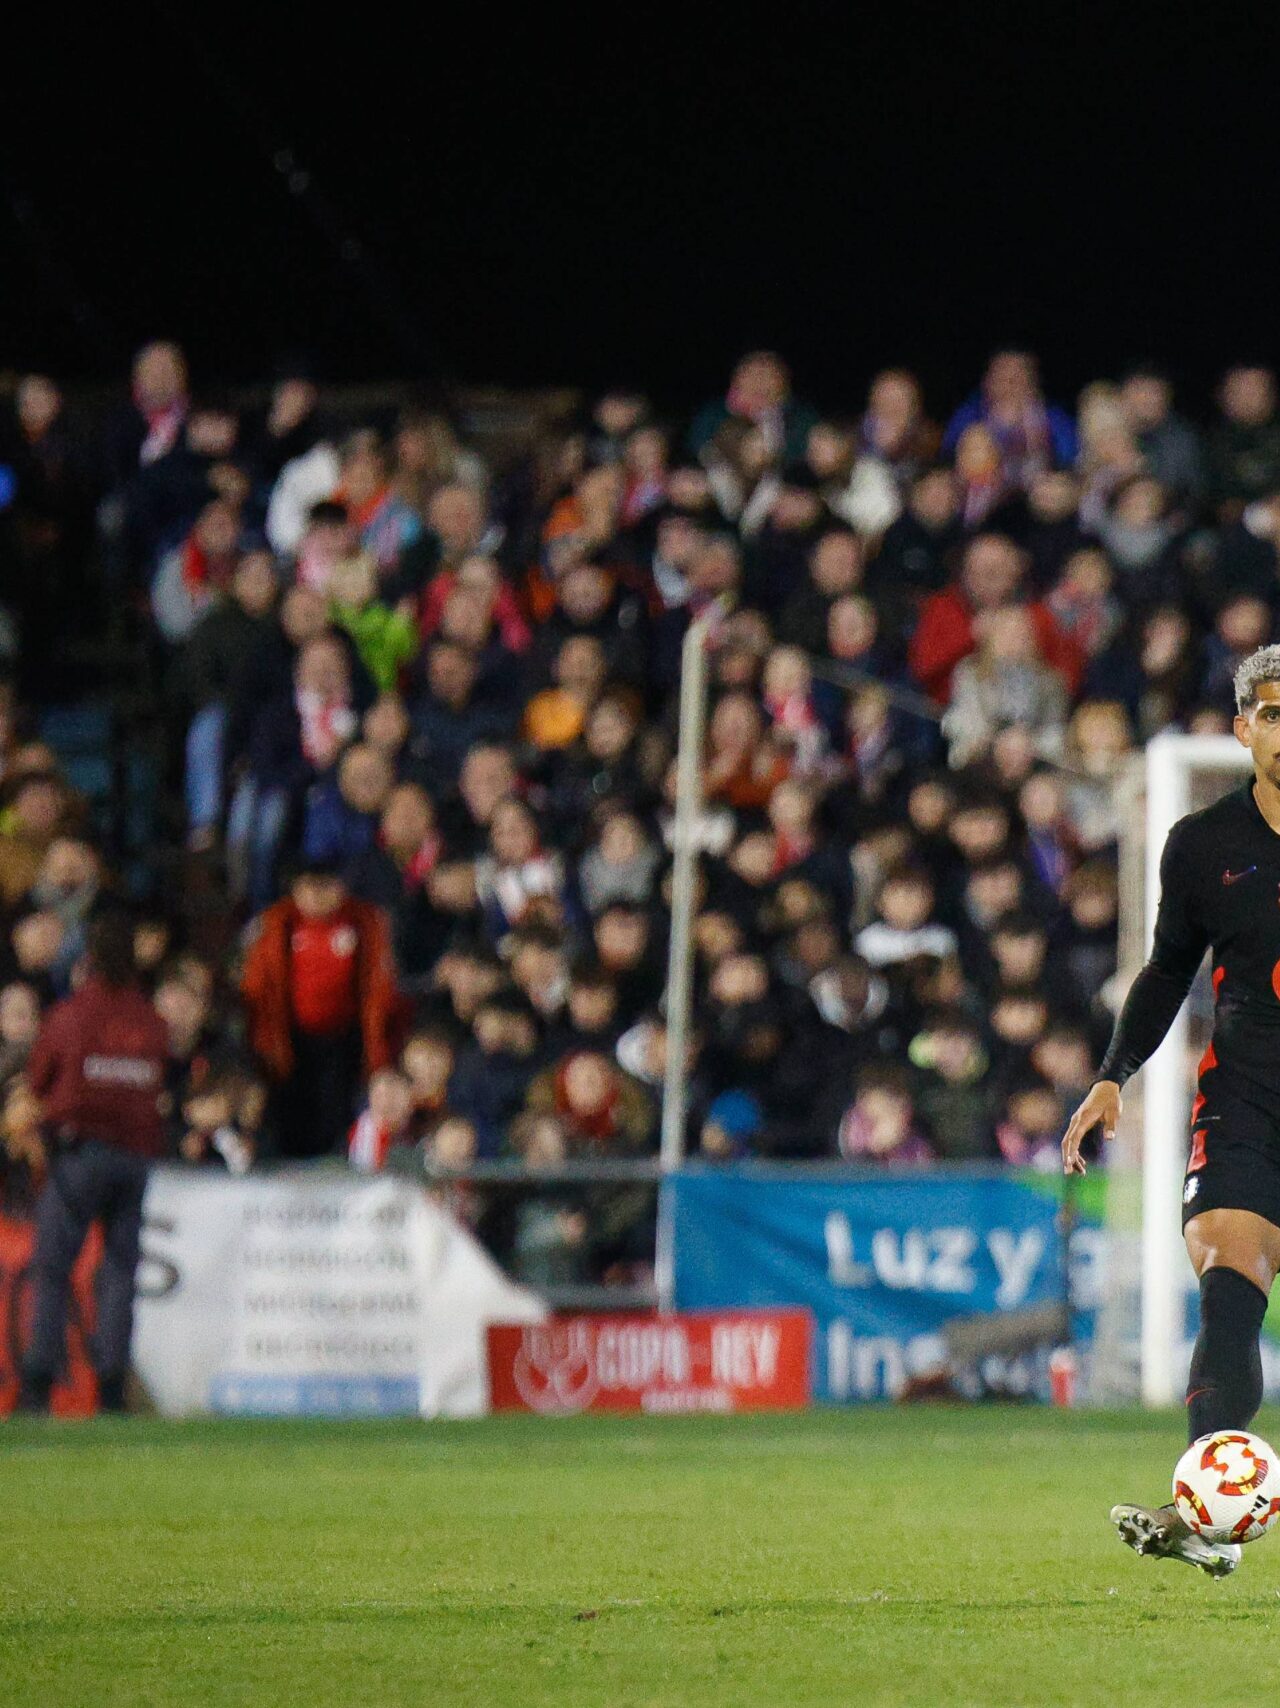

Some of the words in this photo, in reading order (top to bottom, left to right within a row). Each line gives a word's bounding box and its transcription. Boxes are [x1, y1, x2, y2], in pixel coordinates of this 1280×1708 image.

[826, 1211, 979, 1294] Luz
[598, 1320, 688, 1388] COPA
[711, 1320, 782, 1386] REY
